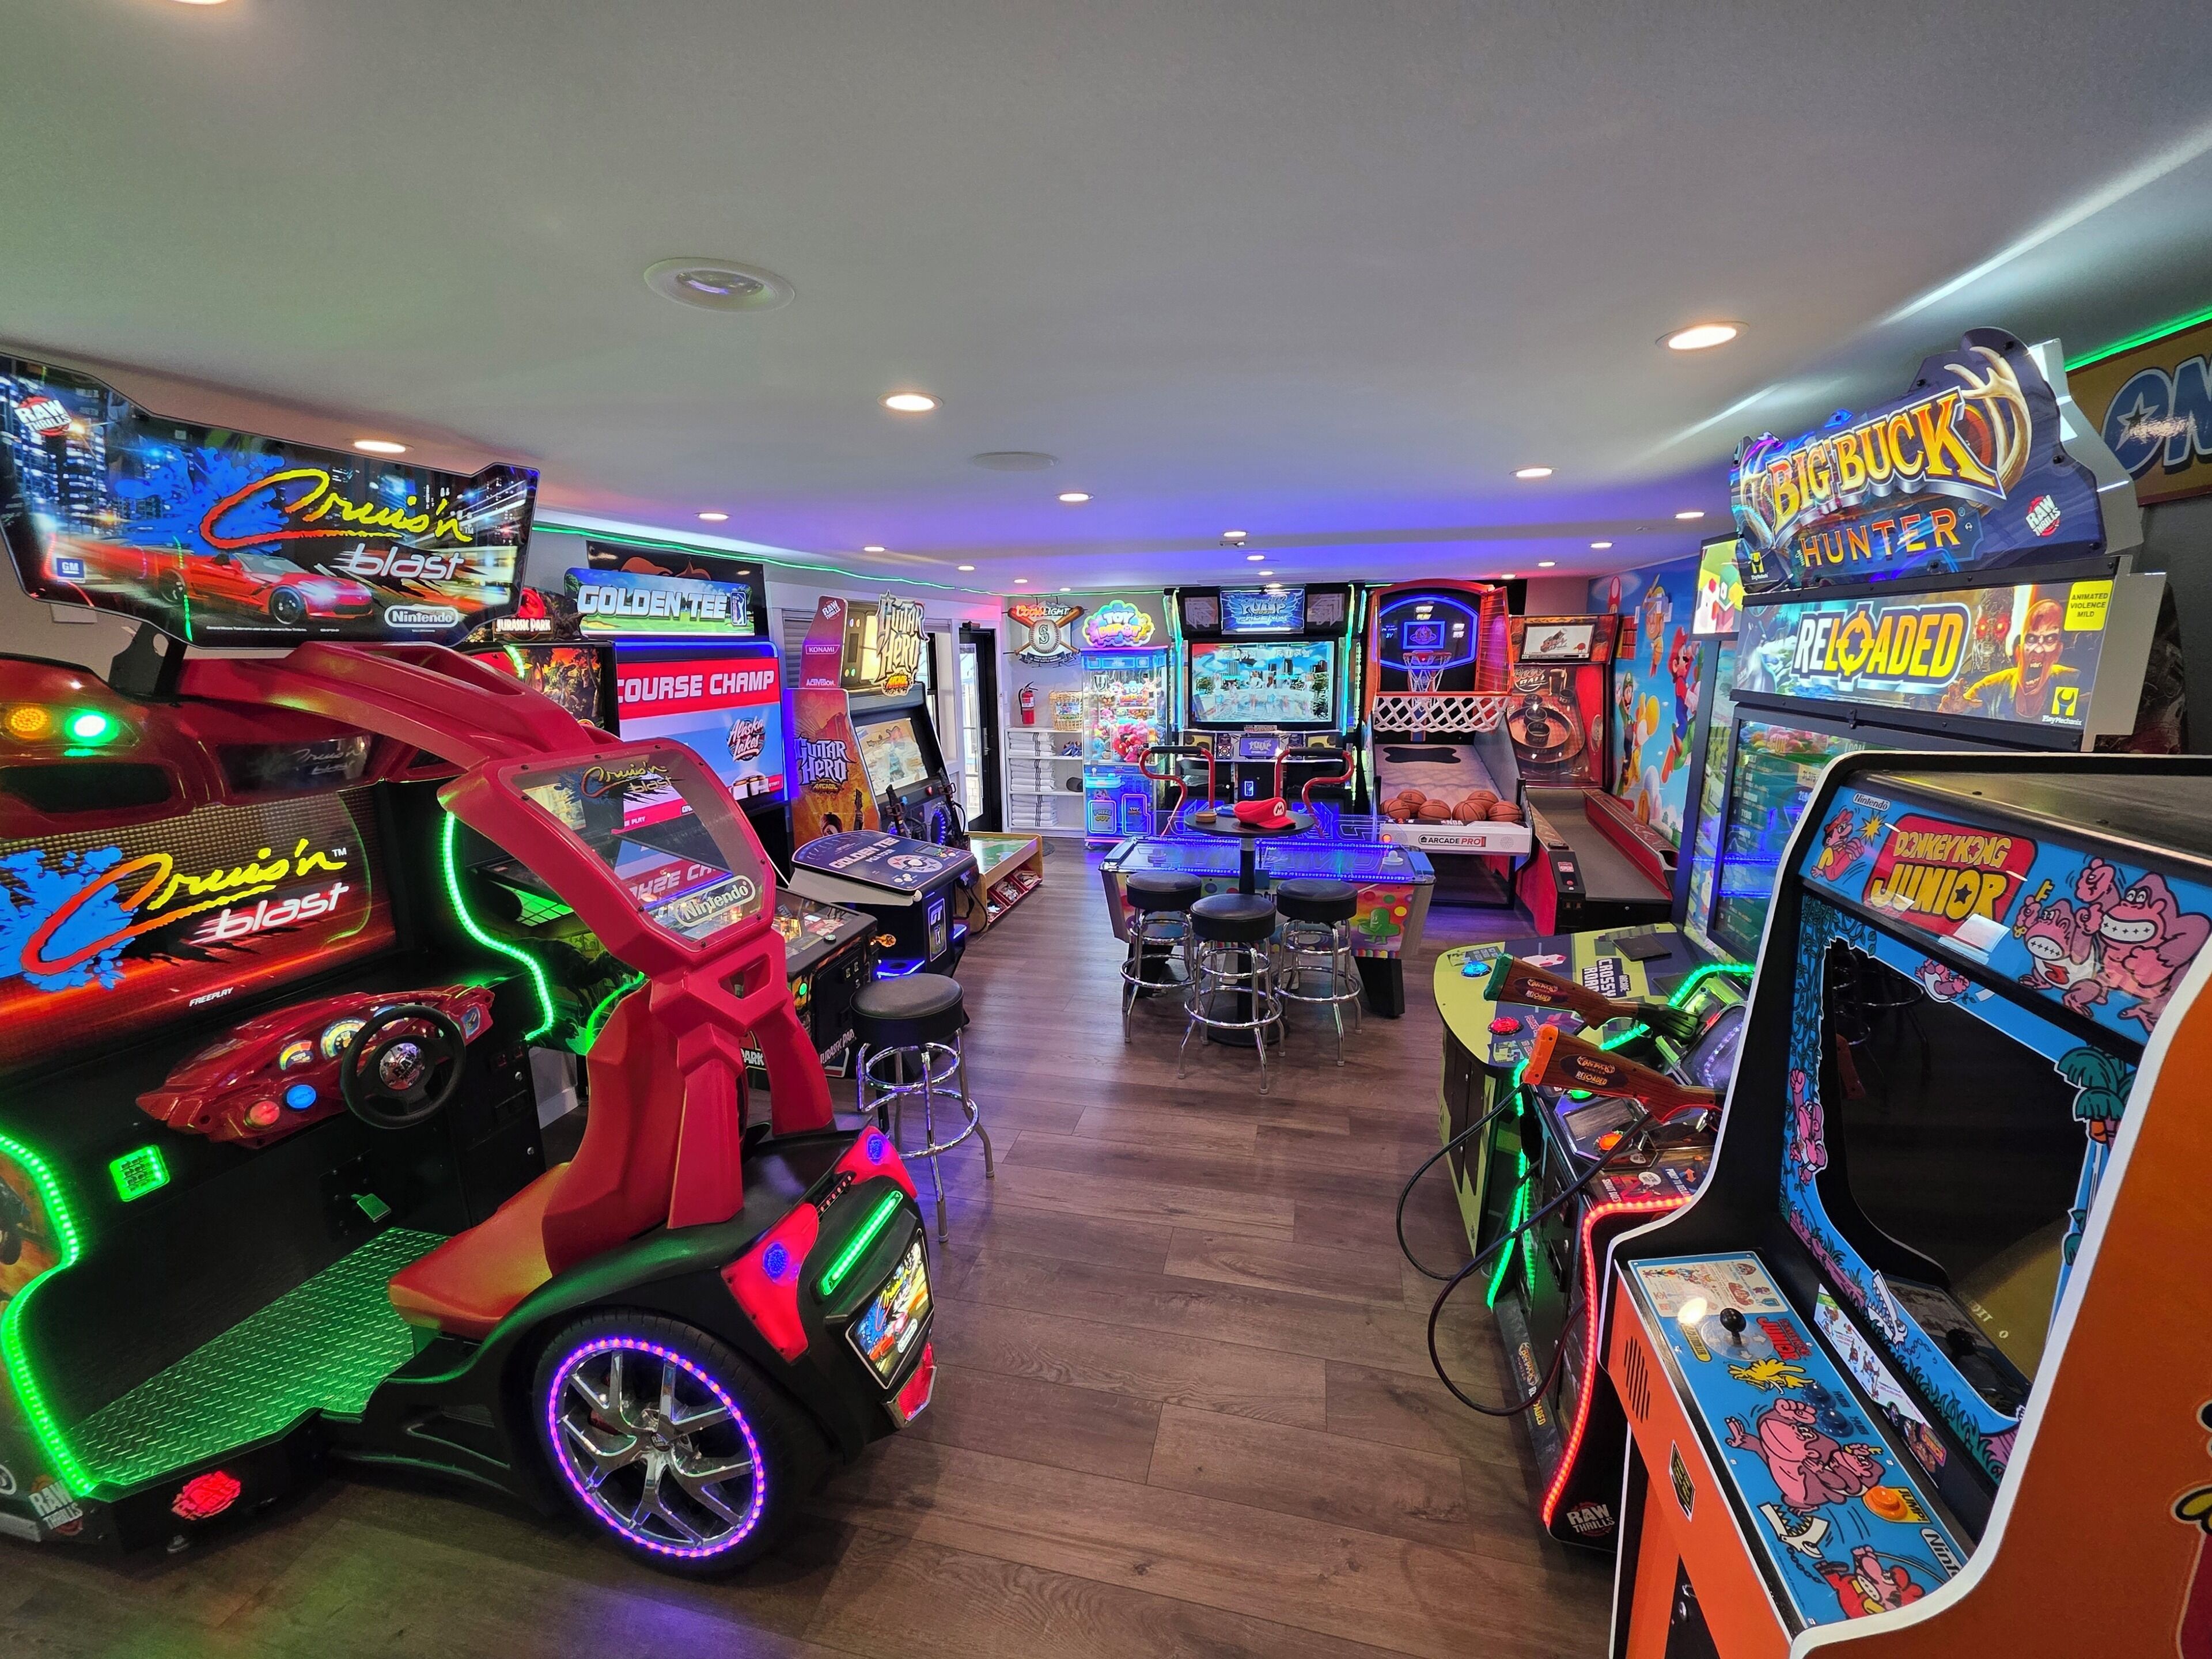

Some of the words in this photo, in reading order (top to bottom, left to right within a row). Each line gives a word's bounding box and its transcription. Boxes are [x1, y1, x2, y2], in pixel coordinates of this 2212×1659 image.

[14, 400, 68, 423] RAW
[25, 414, 72, 431] THRILLS
[1767, 433, 1833, 537] BIG
[1832, 387, 2007, 498] BUCK
[2026, 494, 2055, 529] RAW
[2034, 507, 2061, 536] THRILLS
[1799, 508, 1960, 567] HUNTER
[62, 561, 79, 573] GM
[347, 543, 464, 580] blast
[577, 584, 682, 618] GOLDEN
[688, 593, 728, 619] TEE
[822, 599, 838, 615] RAW
[1043, 608, 1071, 616] LIGHT
[392, 611, 453, 623] Nintendo
[496, 618, 529, 632] JURASSIC
[530, 619, 551, 632] PARK
[877, 595, 929, 644] GUITAR
[1103, 611, 1135, 624] TOY
[1039, 624, 1049, 644] S
[1795, 604, 1961, 681] RELOADED
[709, 671, 775, 695] CHAMP
[728, 716, 764, 745] Alaska
[733, 735, 760, 762] Lakes
[794, 737, 855, 766] GUITAR
[1275, 805, 1283, 815] M
[1854, 794, 1888, 809] Nintendo
[828, 845, 878, 869] GOLDEN
[873, 836, 900, 850] TEE
[1895, 831, 1957, 863] DONKEY
[1956, 835, 2012, 869] KONG
[681, 884, 749, 921] Nintendo
[1871, 865, 2007, 922] JUNIOR
[213, 882, 350, 941] blast
[1599, 959, 1616, 997] CROSSY
[189, 987, 234, 1007] FREEPLAY
[1575, 1071, 1608, 1085] RELOADED
[1757, 1317, 1801, 1361] JUNIOR
[1528, 1385, 1547, 1426] READED
[29, 1480, 74, 1517] RAW
[1566, 1503, 1609, 1522] RAW
[1899, 1489, 1928, 1522] JUMP!
[43, 1502, 84, 1530] THRILLS
[1572, 1518, 1615, 1535] THRILLS
[1925, 1534, 1960, 1573] Nint
